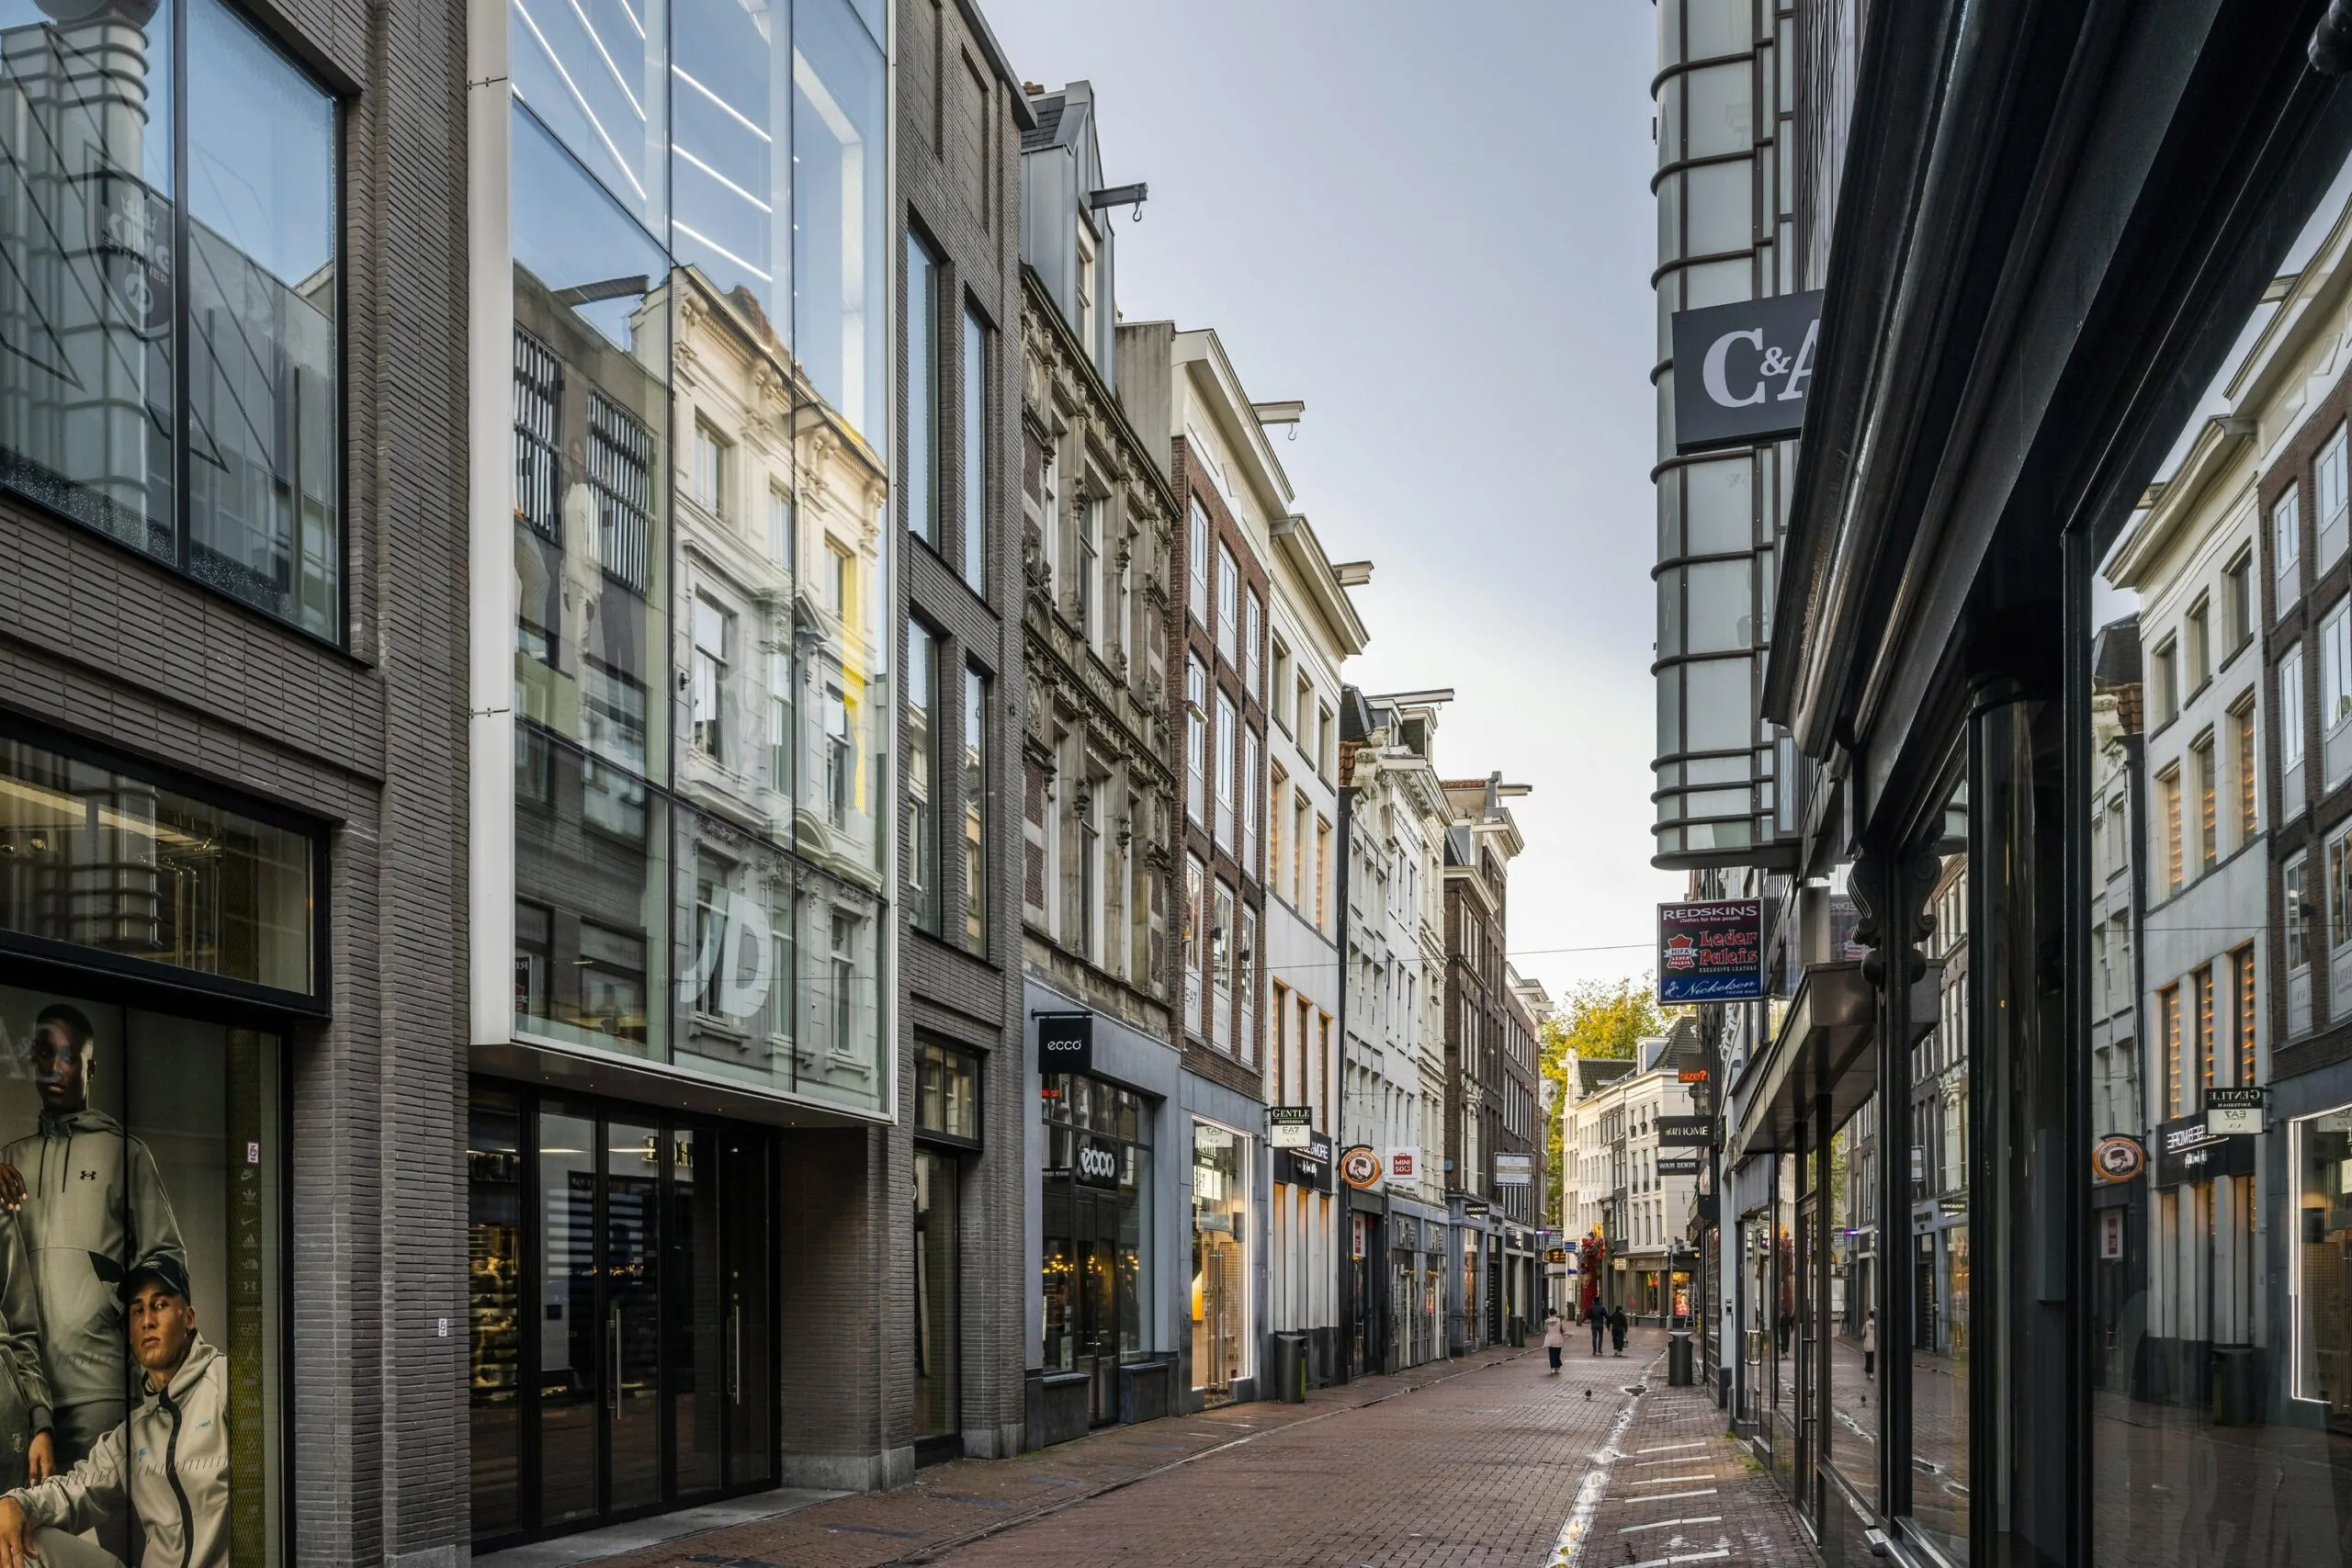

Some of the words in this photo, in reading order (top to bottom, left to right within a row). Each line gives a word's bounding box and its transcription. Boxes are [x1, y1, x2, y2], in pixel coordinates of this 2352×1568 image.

[1703, 318, 1821, 407] C&A
[1663, 906, 1757, 920] REDSKINS
[1700, 930, 1758, 947] Leder
[680, 883, 773, 1017] JD
[1699, 948, 1758, 966] Paleis
[1677, 978, 1756, 998] Nickelson
[1047, 1040, 1081, 1051] ecco
[1679, 1069, 1707, 1082] size?
[1272, 1109, 1310, 1118] GENTLE
[1679, 1125, 1708, 1136] HOME
[1081, 1147, 1114, 1178] ecco
[1658, 1161, 1675, 1169] WAM
